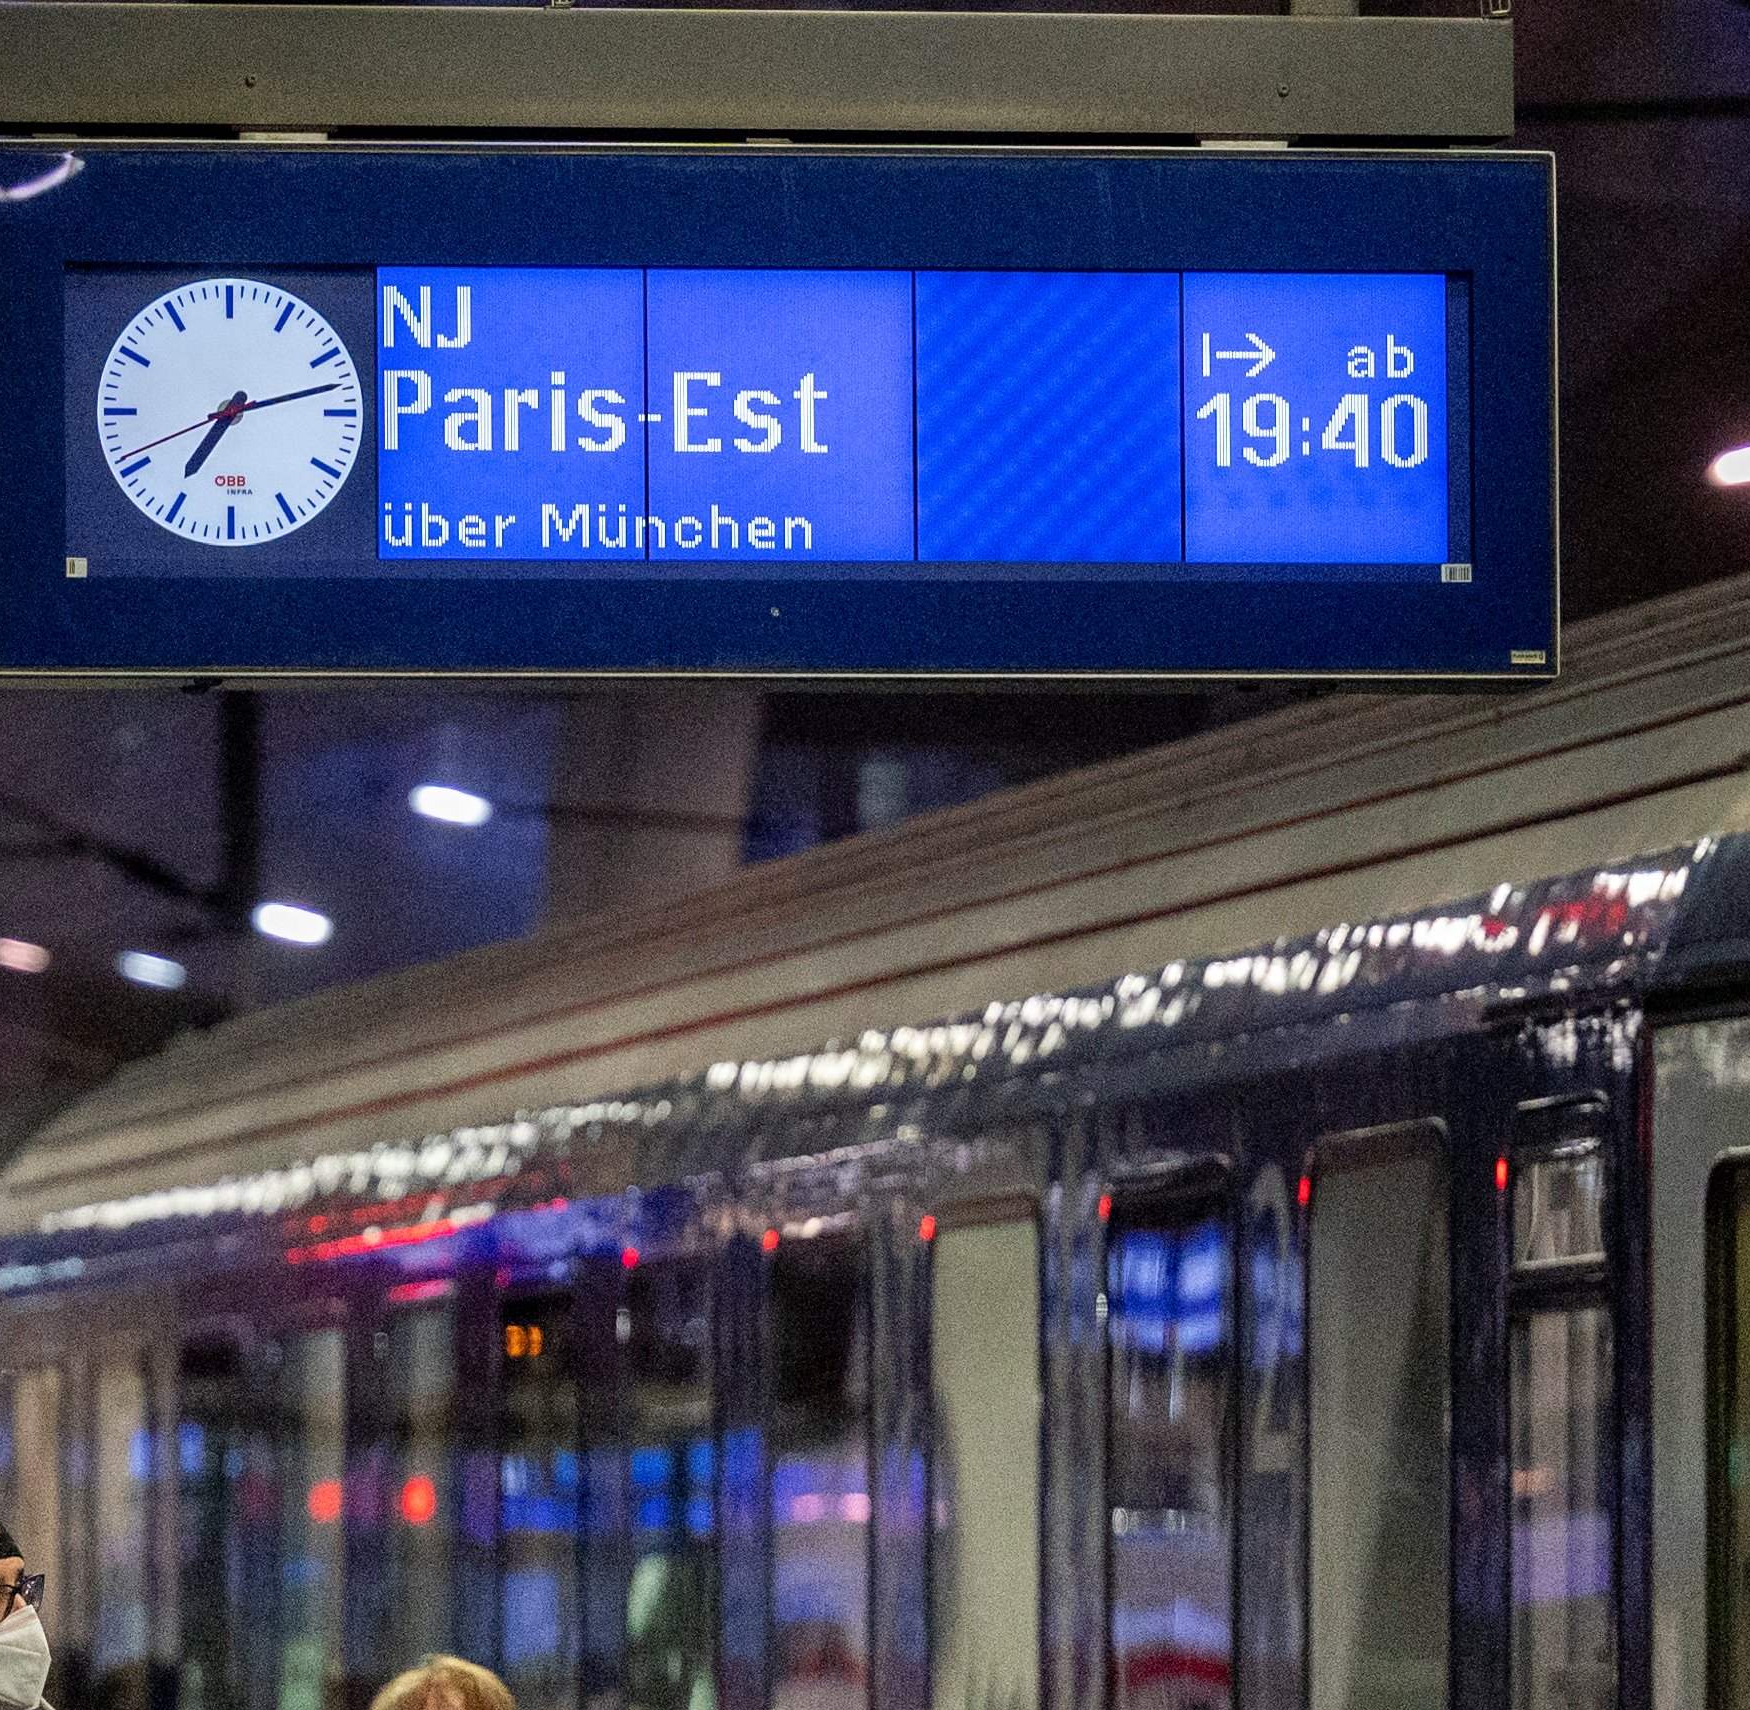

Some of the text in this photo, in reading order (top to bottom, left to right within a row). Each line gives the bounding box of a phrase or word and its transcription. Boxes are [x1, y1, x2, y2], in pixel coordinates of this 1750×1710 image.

[383, 285, 472, 348] NJ
[1347, 334, 1414, 378] ab
[383, 370, 829, 454] Paris-Est
[1196, 392, 1428, 468] 19:40
[384, 502, 813, 549] über München
